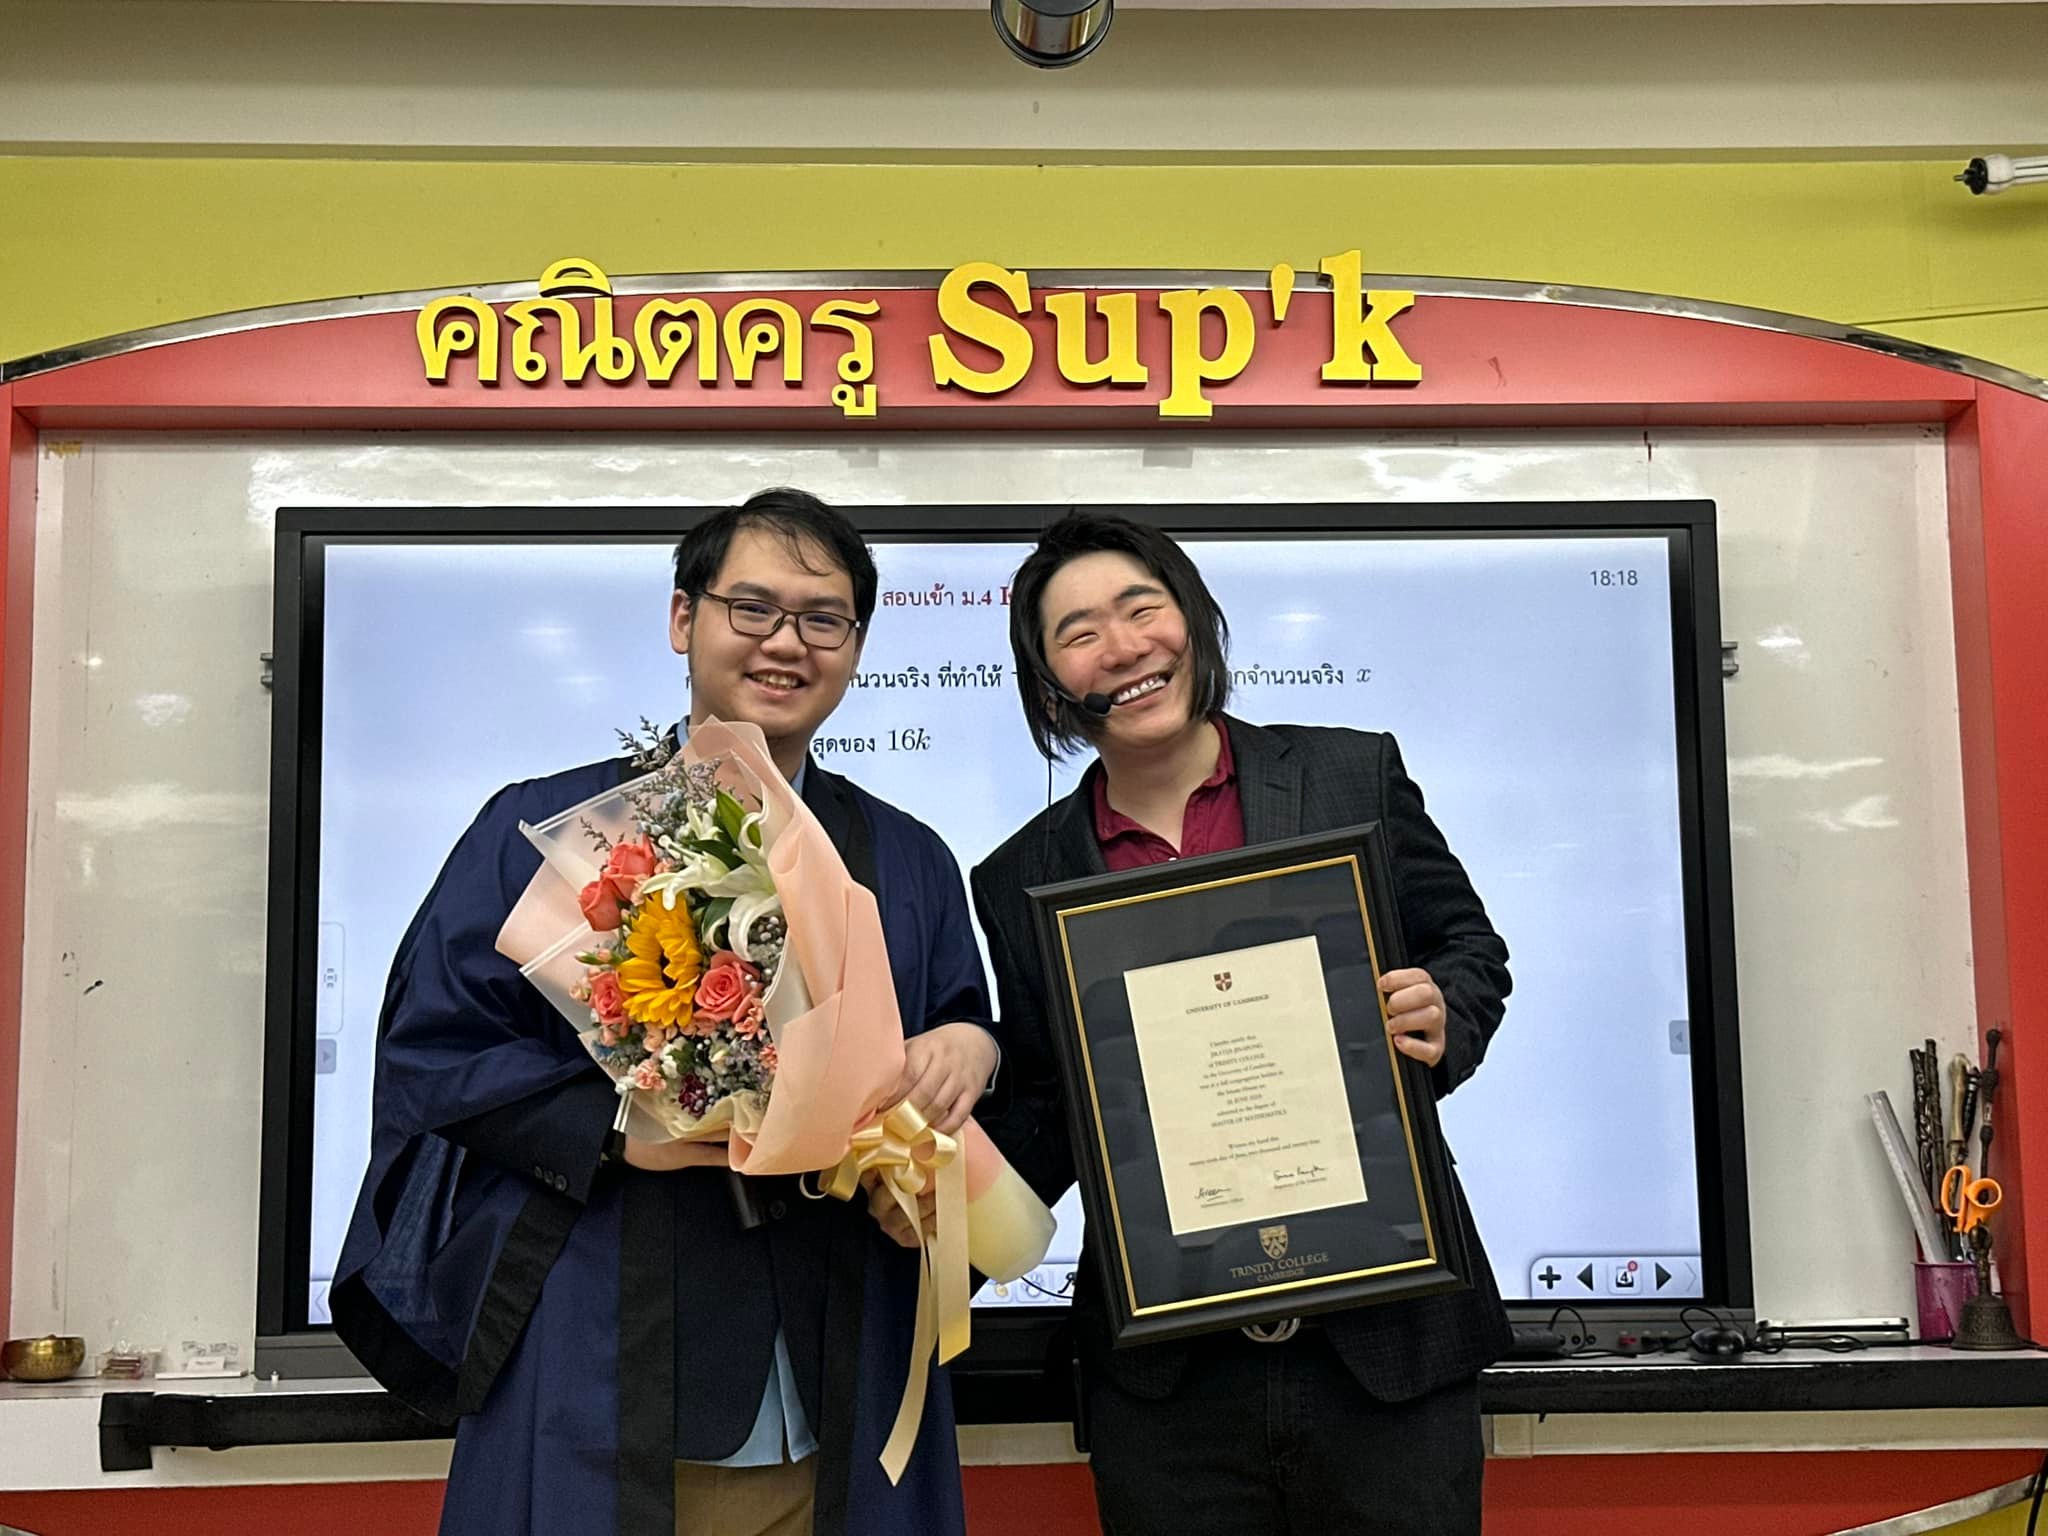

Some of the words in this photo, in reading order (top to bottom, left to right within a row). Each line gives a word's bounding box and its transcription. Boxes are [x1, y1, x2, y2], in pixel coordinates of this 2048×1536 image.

[415, 257, 881, 417] คณิตครู
[928, 250, 1423, 419] Sup'k
[1590, 570, 1638, 587] 18:18
[882, 583, 954, 606] สอบเข้า
[961, 590, 992, 606] ม.4
[937, 661, 1002, 688] ที่ทำให้
[1356, 668, 1371, 683] x
[887, 728, 931, 751] 16k
[1229, 1261, 1275, 1279] TRINITY
[1277, 1252, 1329, 1270] COLLEGE
